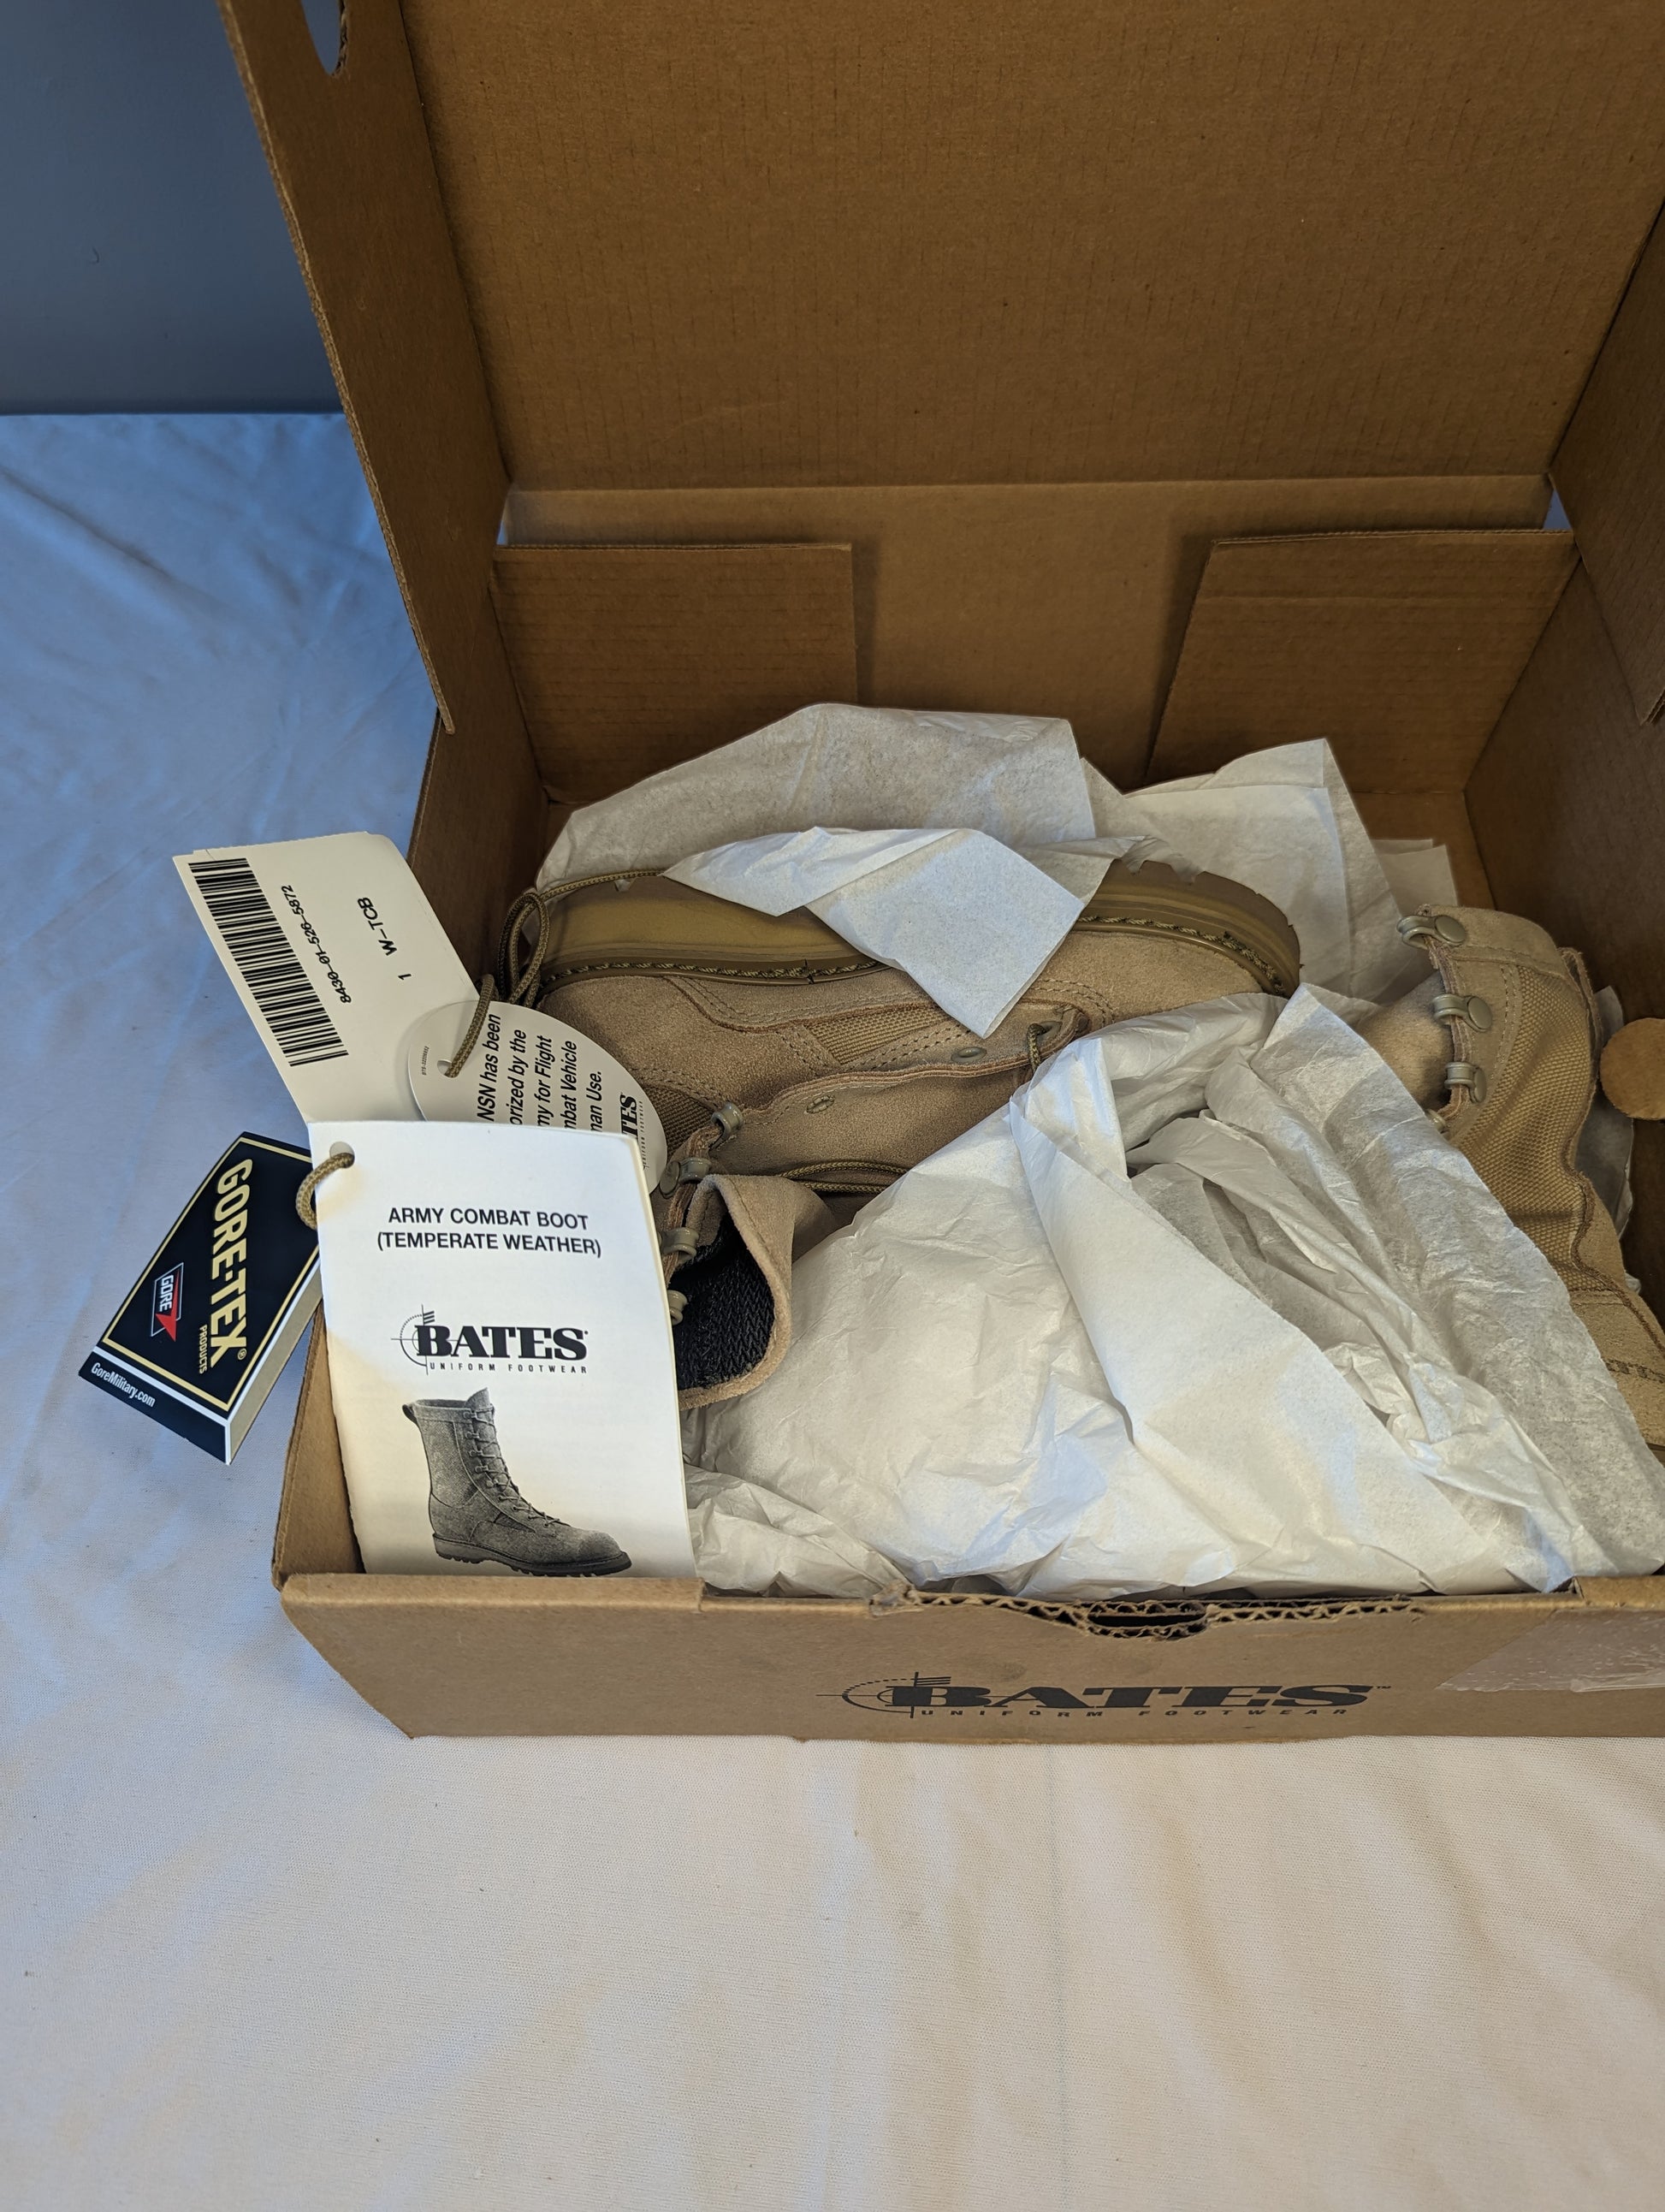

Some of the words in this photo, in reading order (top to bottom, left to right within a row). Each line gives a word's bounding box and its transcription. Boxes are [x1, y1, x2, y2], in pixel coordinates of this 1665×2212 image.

[281, 885, 352, 1004] 8430-01-526-5872
[357, 897, 398, 956] W-TCB
[482, 1014, 501, 1052] been
[509, 1029, 526, 1053] the
[480, 1053, 499, 1082] has
[507, 1055, 529, 1076] by
[534, 1035, 555, 1078] Flight
[560, 1041, 578, 1091] Vehicle
[477, 1083, 496, 1122] NSN
[534, 1079, 551, 1103] for
[585, 1071, 602, 1101] Use.
[388, 1207, 444, 1224] ARMY
[450, 1207, 530, 1227] COMBAT
[536, 1211, 589, 1231] BOOT
[376, 1231, 497, 1251] (TEMPERATE
[502, 1233, 601, 1259] WEATHER)
[159, 1274, 175, 1313] GORE
[198, 1324, 208, 1374] PRODUCTS
[430, 1361, 495, 1372] UNIFORM
[507, 1362, 588, 1374] FOOTWEAR
[91, 1361, 156, 1408] GoreMilitary.com
